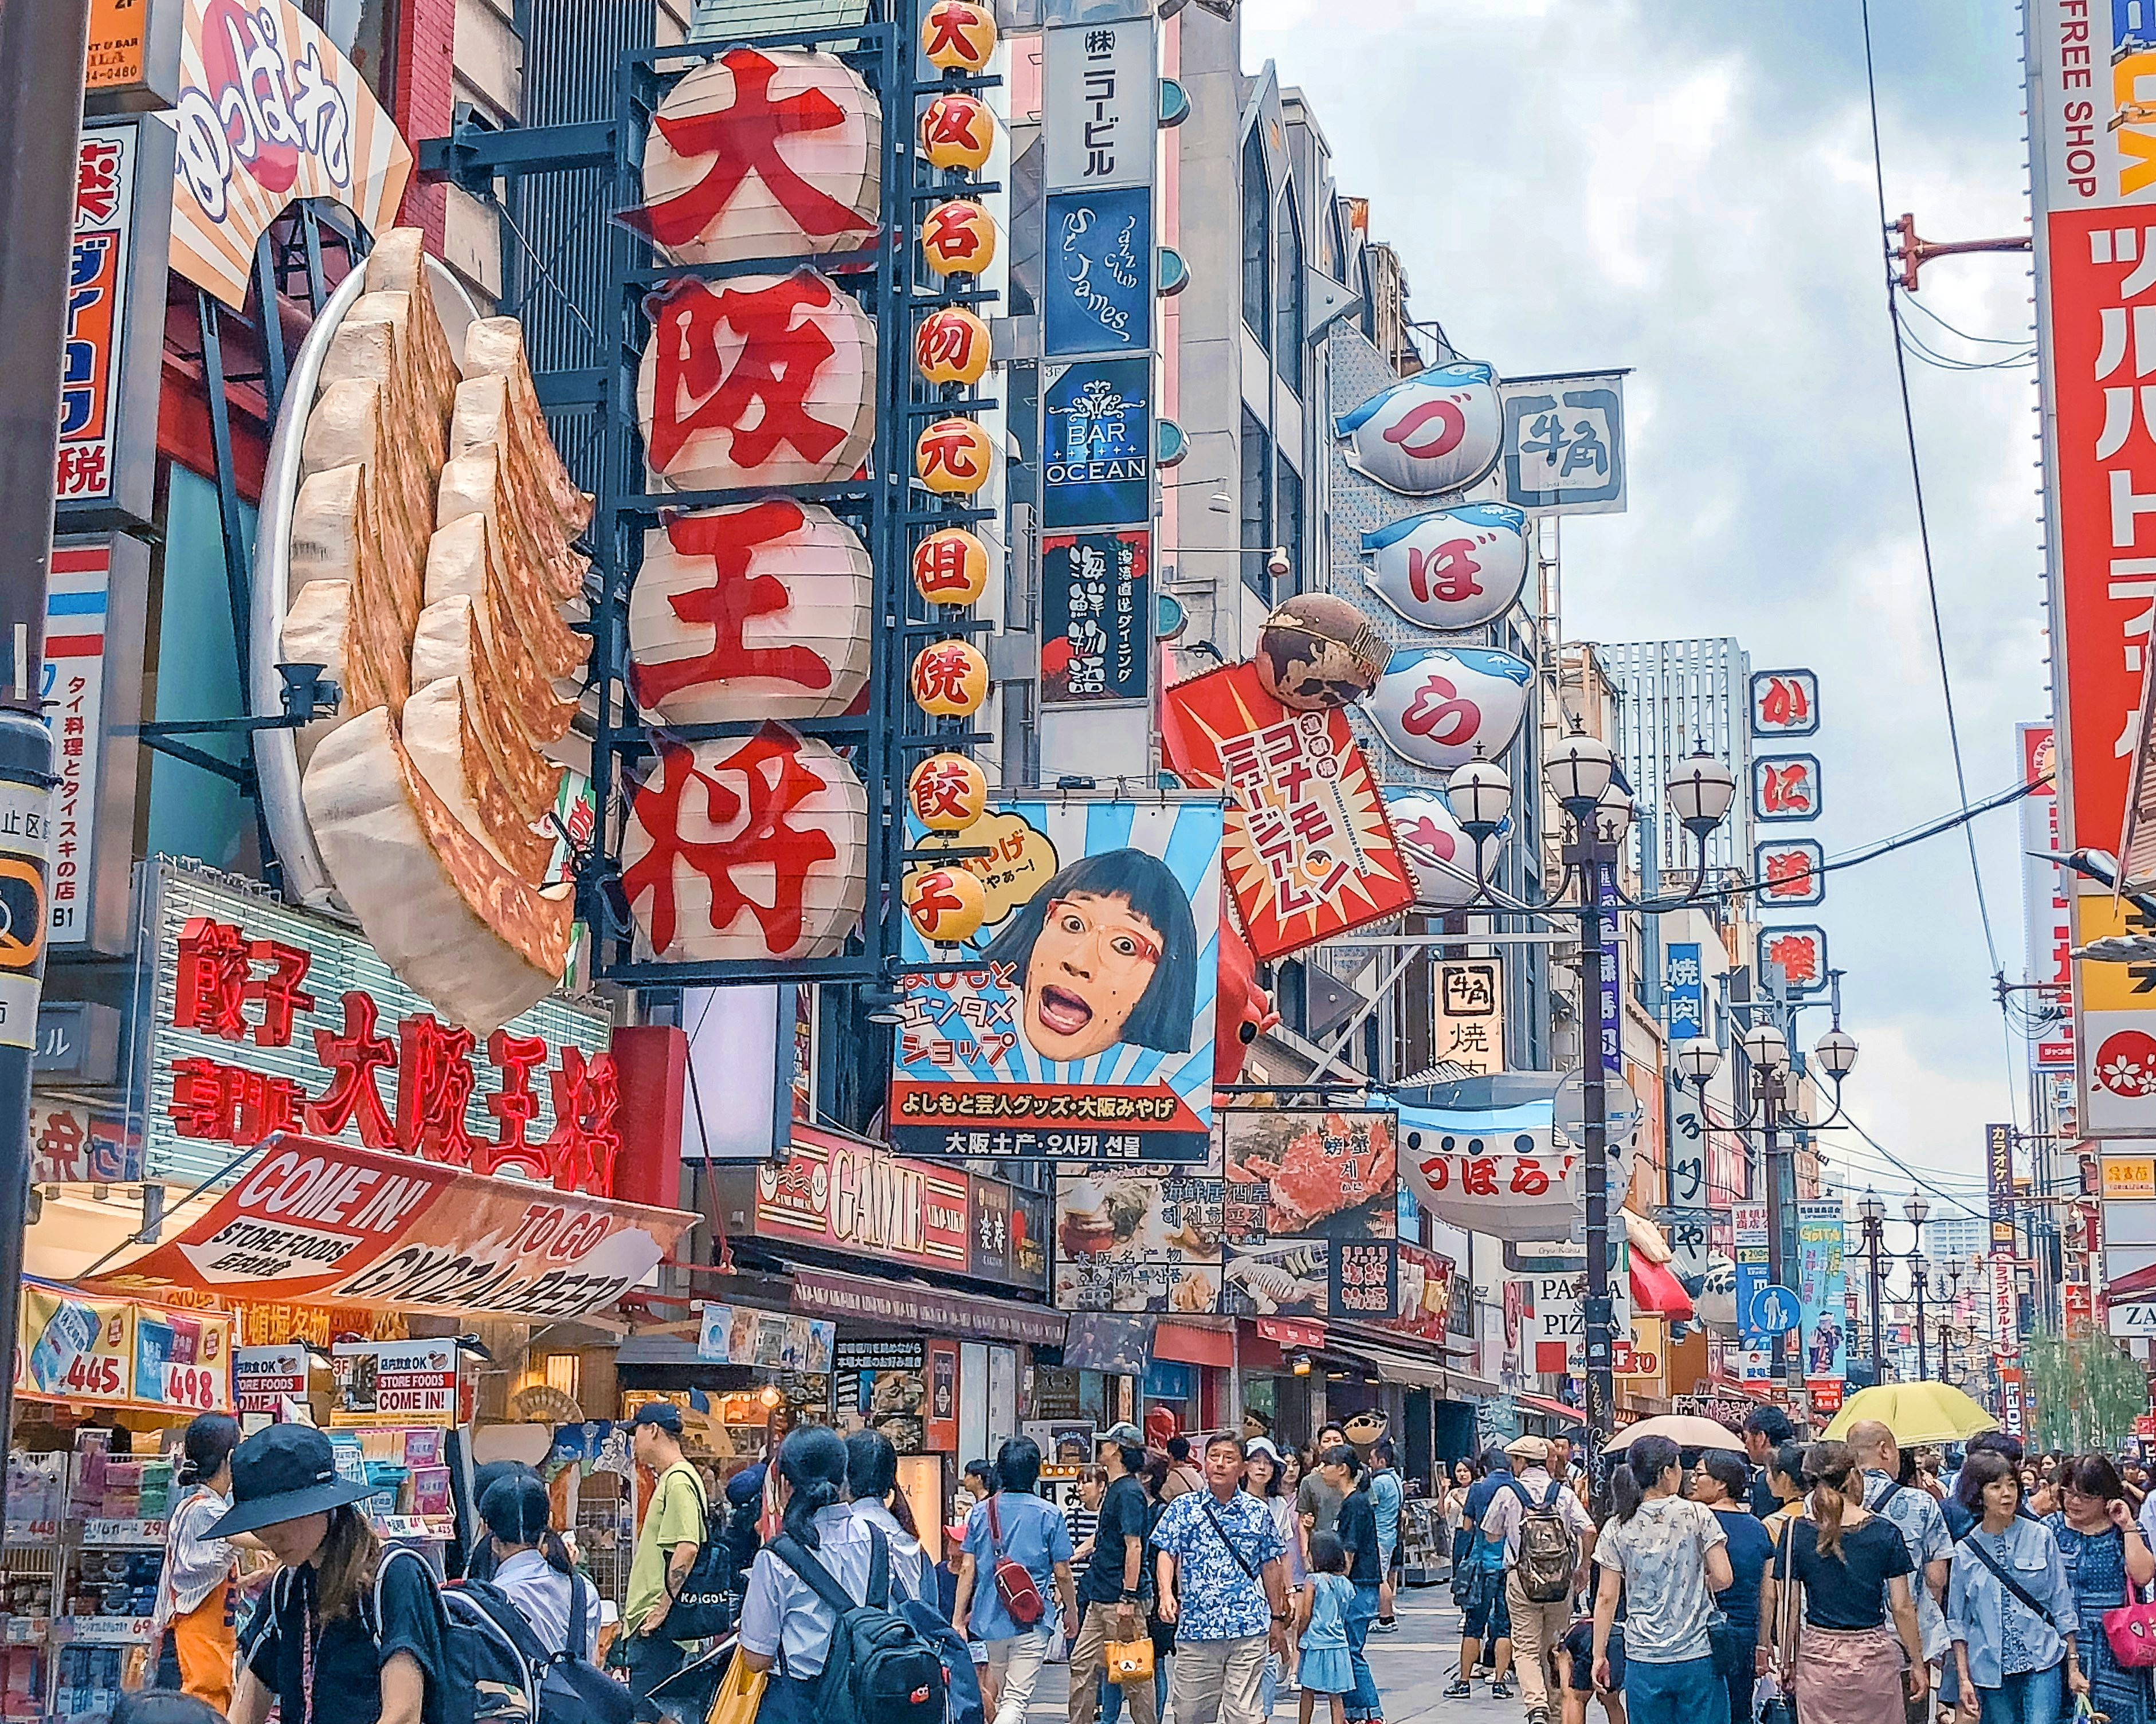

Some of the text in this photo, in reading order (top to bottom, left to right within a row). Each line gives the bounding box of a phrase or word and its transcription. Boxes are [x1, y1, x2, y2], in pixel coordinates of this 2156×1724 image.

[115, 38, 138, 49] BAR
[2060, 0, 2096, 198] FREE SHOP
[1067, 252, 1130, 335] James
[1045, 367, 1061, 378] 3F
[1068, 423, 1125, 446] BAR
[1520, 414, 1608, 478] 牛角
[1046, 459, 1146, 483] OCEAN
[614, 48, 880, 958] 大阪王将
[55, 676, 86, 901] タイ料理とタイスキの店
[53, 907, 74, 928] B1
[175, 917, 314, 1046] 餃子
[1450, 975, 1489, 1005] 牛角
[1668, 957, 1699, 1024] 焼肉
[903, 996, 1017, 1028] エンタメ
[33, 1027, 70, 1057] ル
[901, 1033, 1016, 1066] ショップ
[305, 991, 622, 1197] 大阪王将
[902, 1093, 1174, 1118] よしもと芸人グッズ・大阪みやげ
[1104, 1134, 1140, 1157] 선물
[1992, 1127, 2008, 1181] カラオケ
[1419, 1154, 1578, 1196] づぼら
[238, 1152, 432, 1233] COME IN!
[829, 1148, 926, 1254] GAME
[212, 1222, 354, 1263] STORE FOODS
[504, 1204, 611, 1259] TO GO
[1540, 1279, 1624, 1300] PAA
[1543, 1315, 1625, 1336] PIZ
[67, 1354, 120, 1394] 445
[261, 1361, 276, 1373] OK
[413, 1357, 427, 1370] OK
[169, 1365, 214, 1409] 498
[260, 1377, 294, 1391] FOODS
[380, 1374, 445, 1388] STORE FOODS
[234, 1395, 269, 1411] OME
[379, 1391, 445, 1411] COME IN!
[29, 1520, 56, 1536] 448
